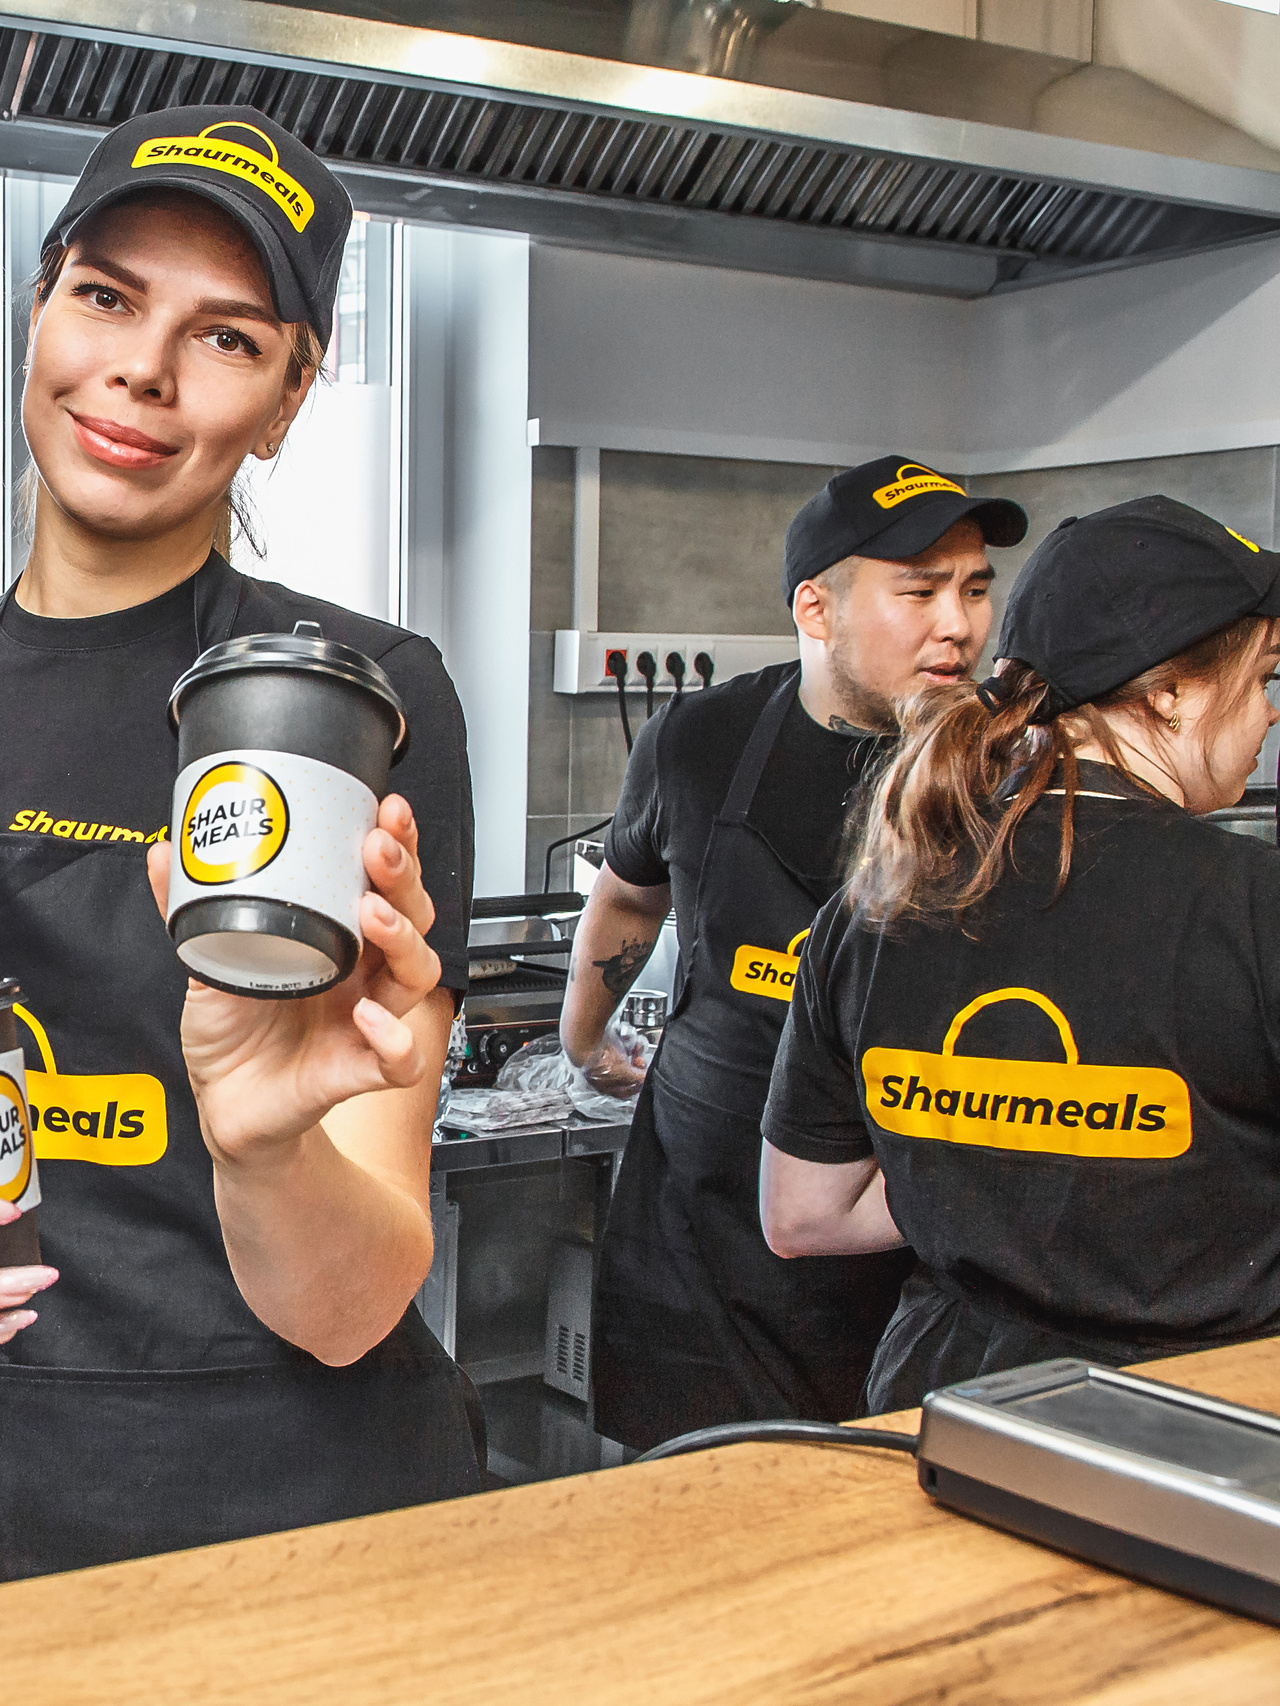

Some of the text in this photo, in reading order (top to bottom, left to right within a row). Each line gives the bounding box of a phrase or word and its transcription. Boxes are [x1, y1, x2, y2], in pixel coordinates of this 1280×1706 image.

[147, 144, 304, 218] Shaurmeals
[187, 798, 266, 837] SHAUR
[191, 818, 274, 854] MEALS
[879, 1074, 1167, 1132] Shaurmeals
